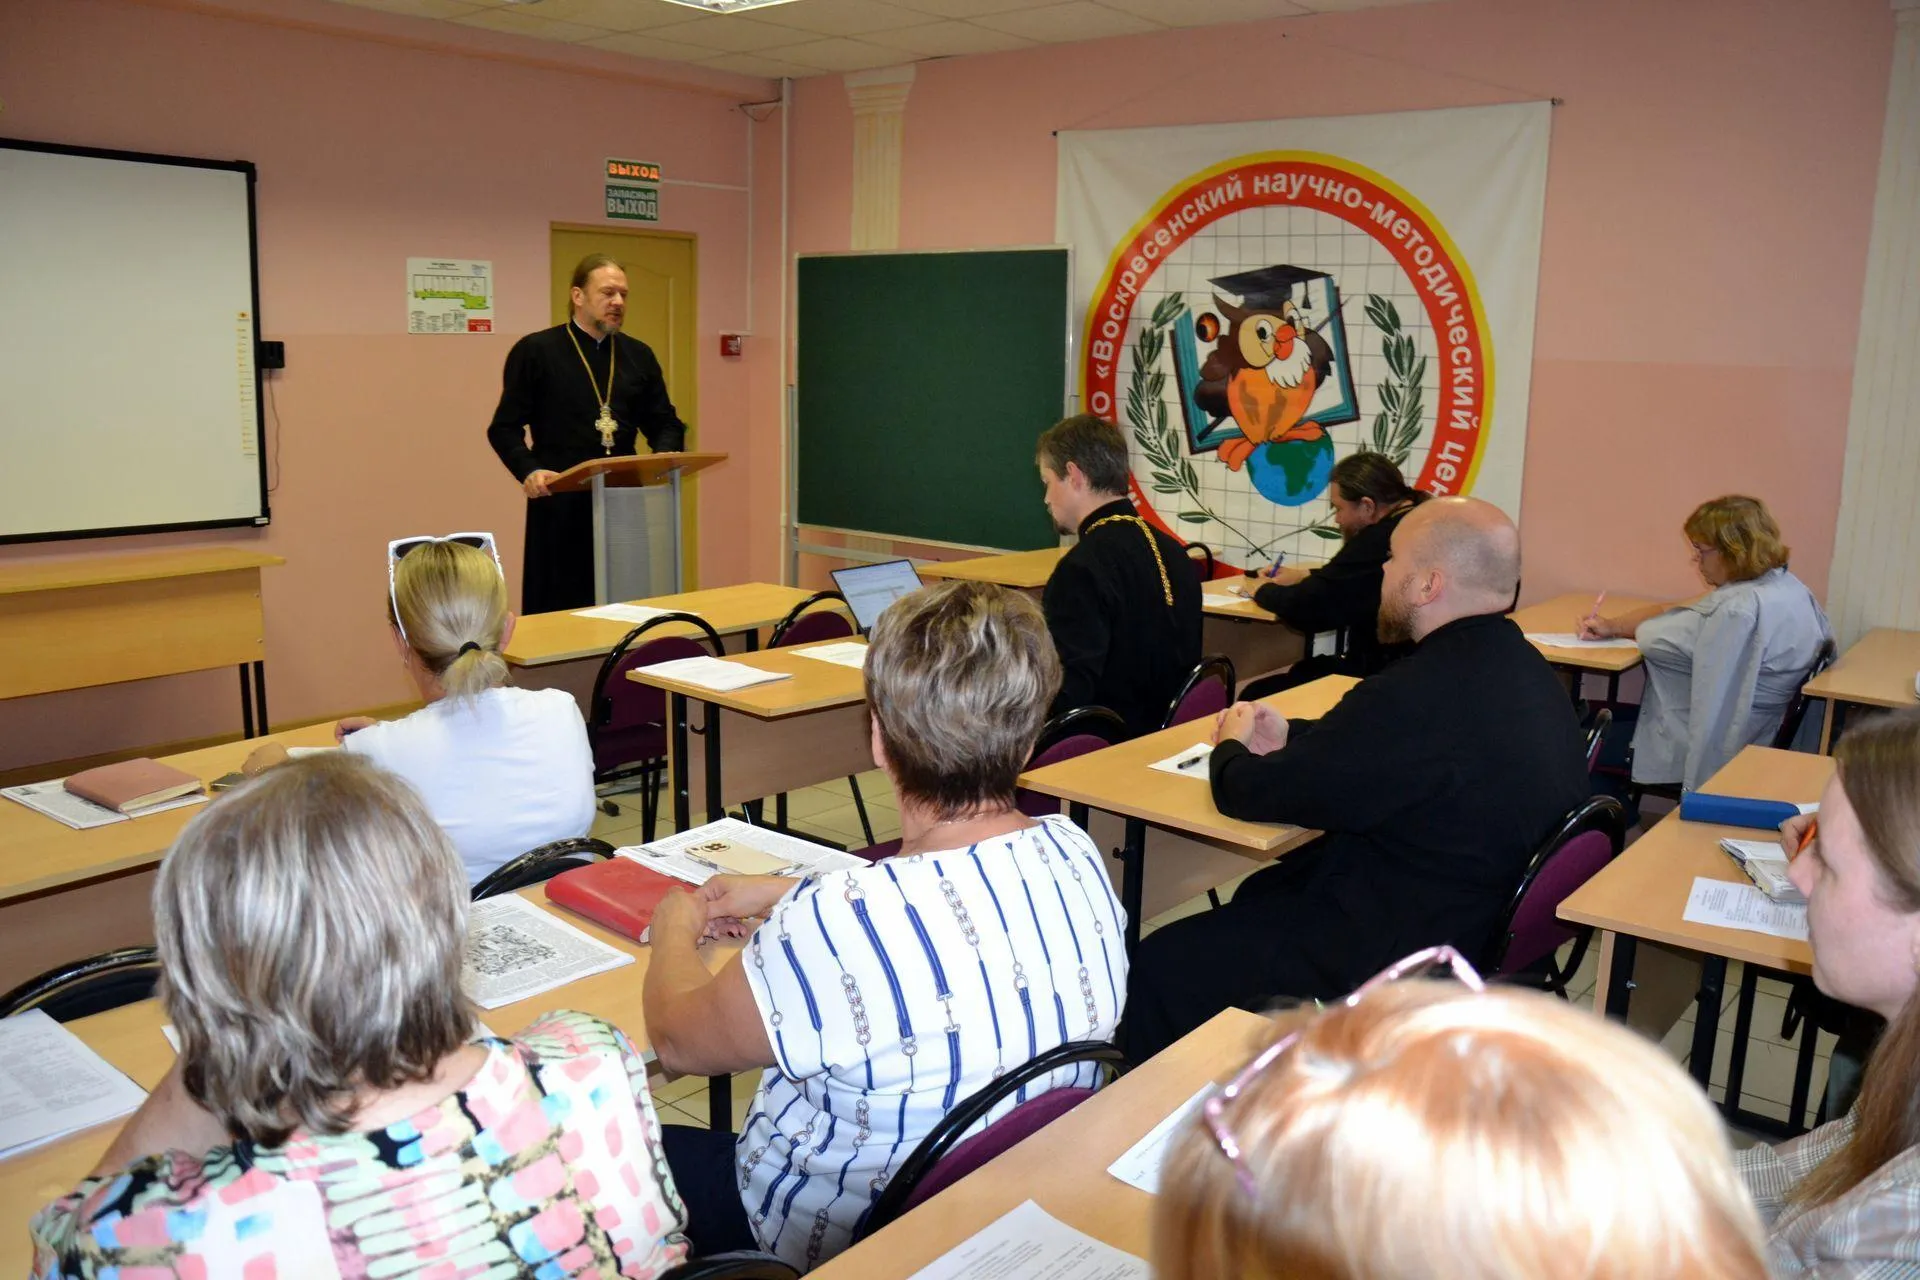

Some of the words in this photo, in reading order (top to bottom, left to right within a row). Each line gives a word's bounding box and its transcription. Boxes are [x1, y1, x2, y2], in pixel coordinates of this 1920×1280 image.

[608, 163, 659, 179] ВЫХОД
[607, 198, 657, 218] ВЫХОД
[1092, 174, 1243, 379] «Воскресенский
[1253, 172, 1479, 431] научно-методический
